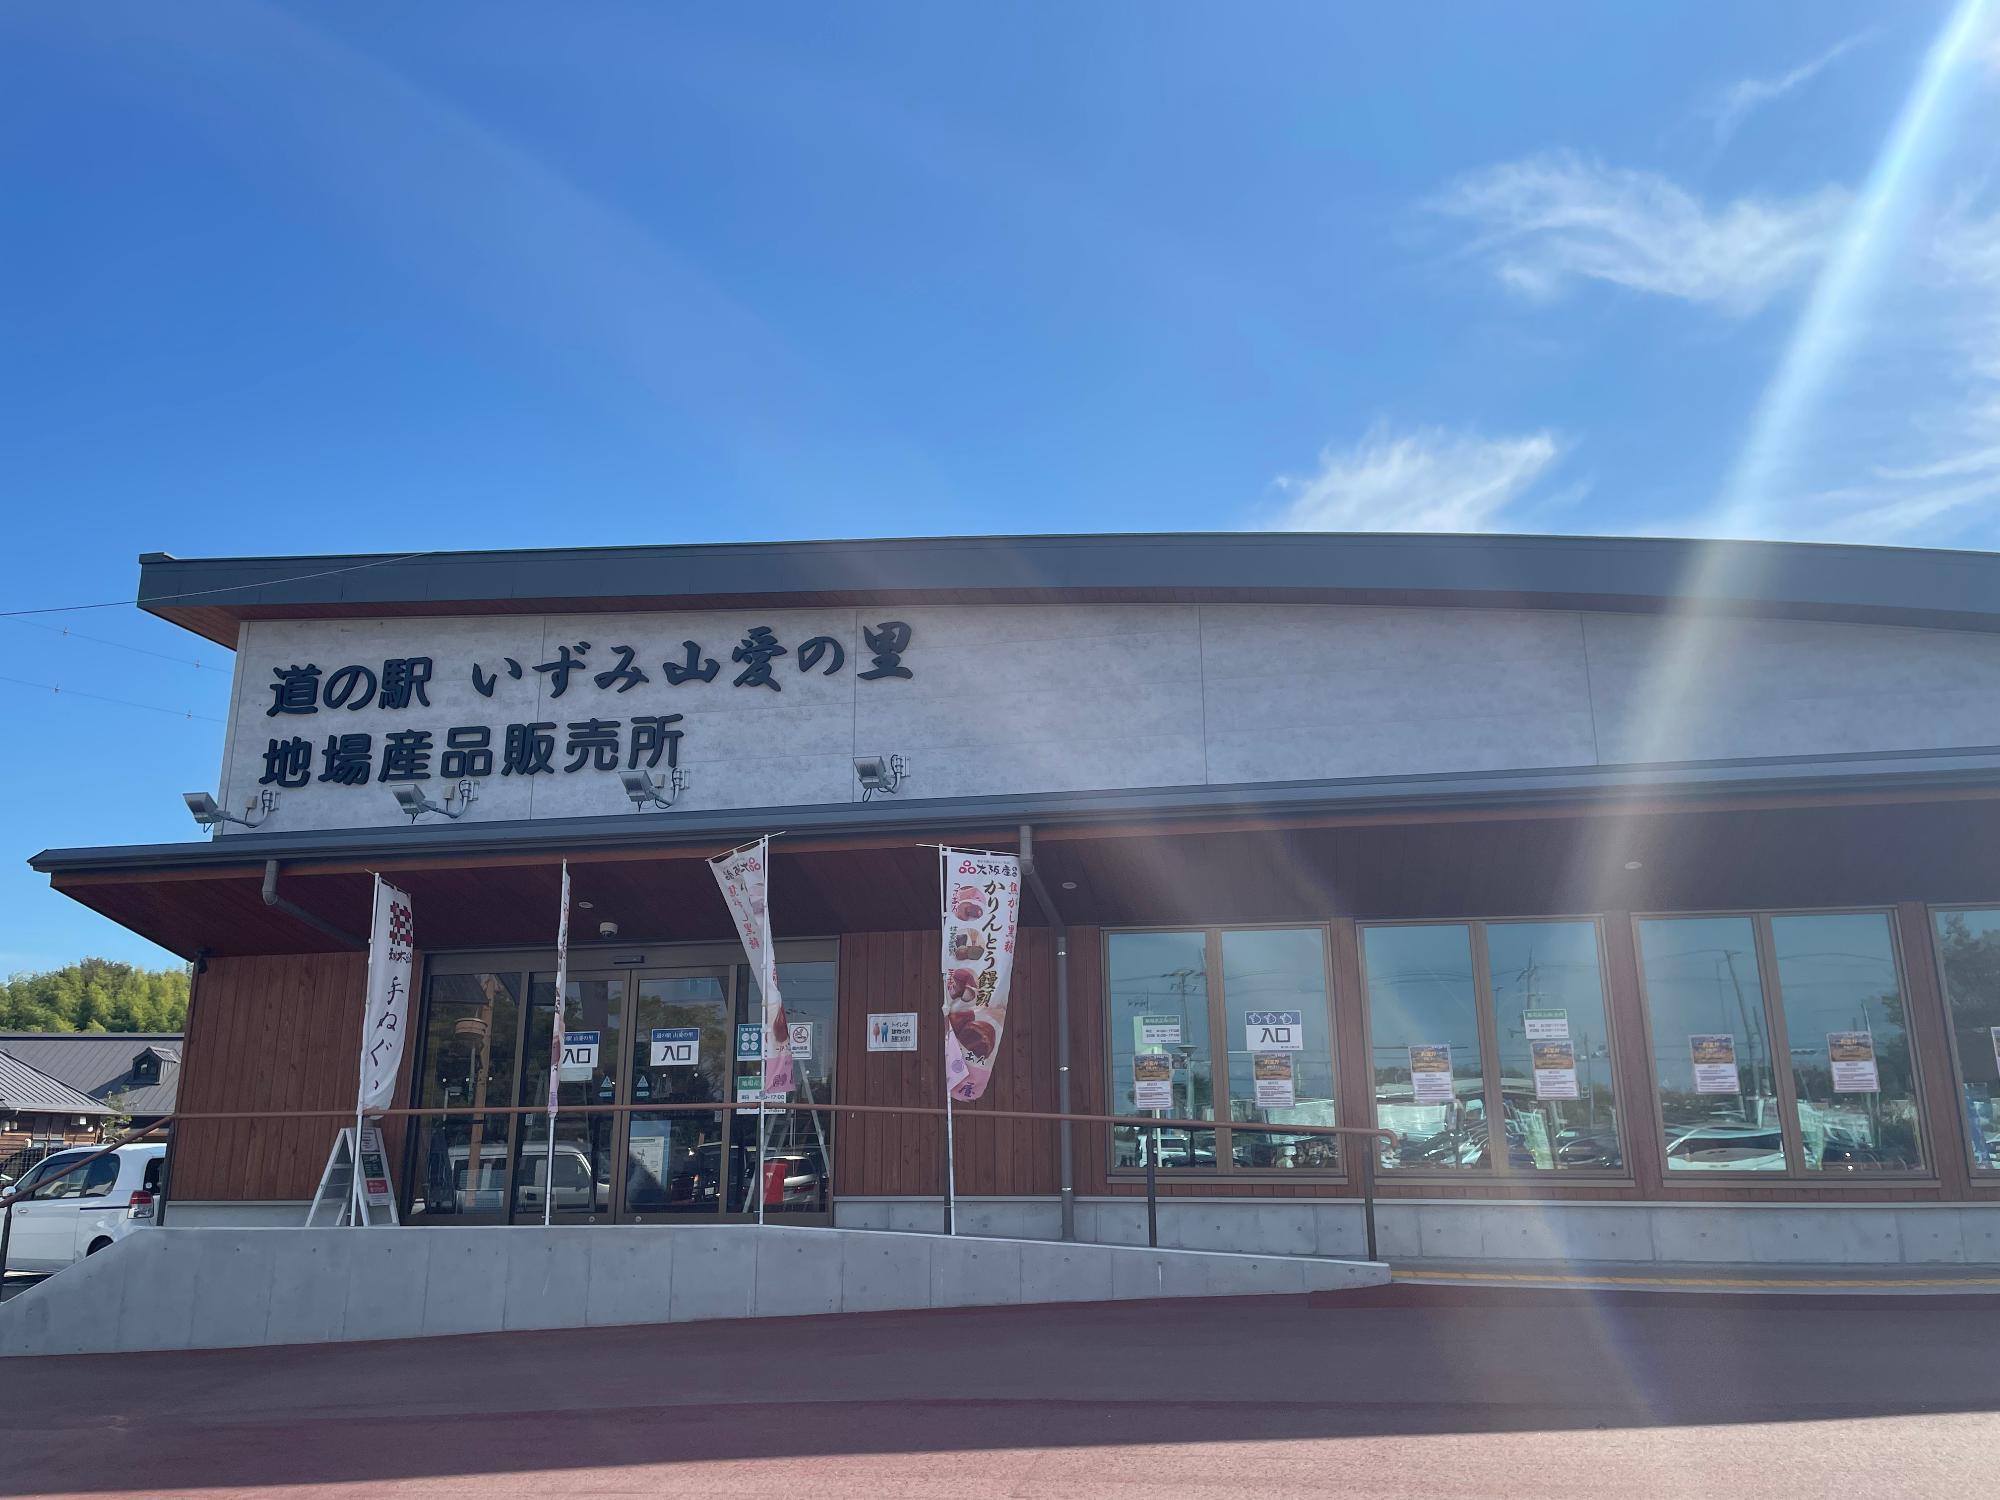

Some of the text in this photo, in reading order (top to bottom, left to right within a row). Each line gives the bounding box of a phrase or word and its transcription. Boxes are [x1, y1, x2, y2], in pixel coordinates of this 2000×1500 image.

[266, 621, 913, 717] 道の駅 いずみ山愛の里
[258, 713, 685, 788] 地場産品販売所
[975, 879, 1006, 1008] かりんとう饅頭
[562, 1048, 592, 1064] 入口
[661, 1045, 692, 1061] 入口
[1260, 1027, 1291, 1043] 入口
